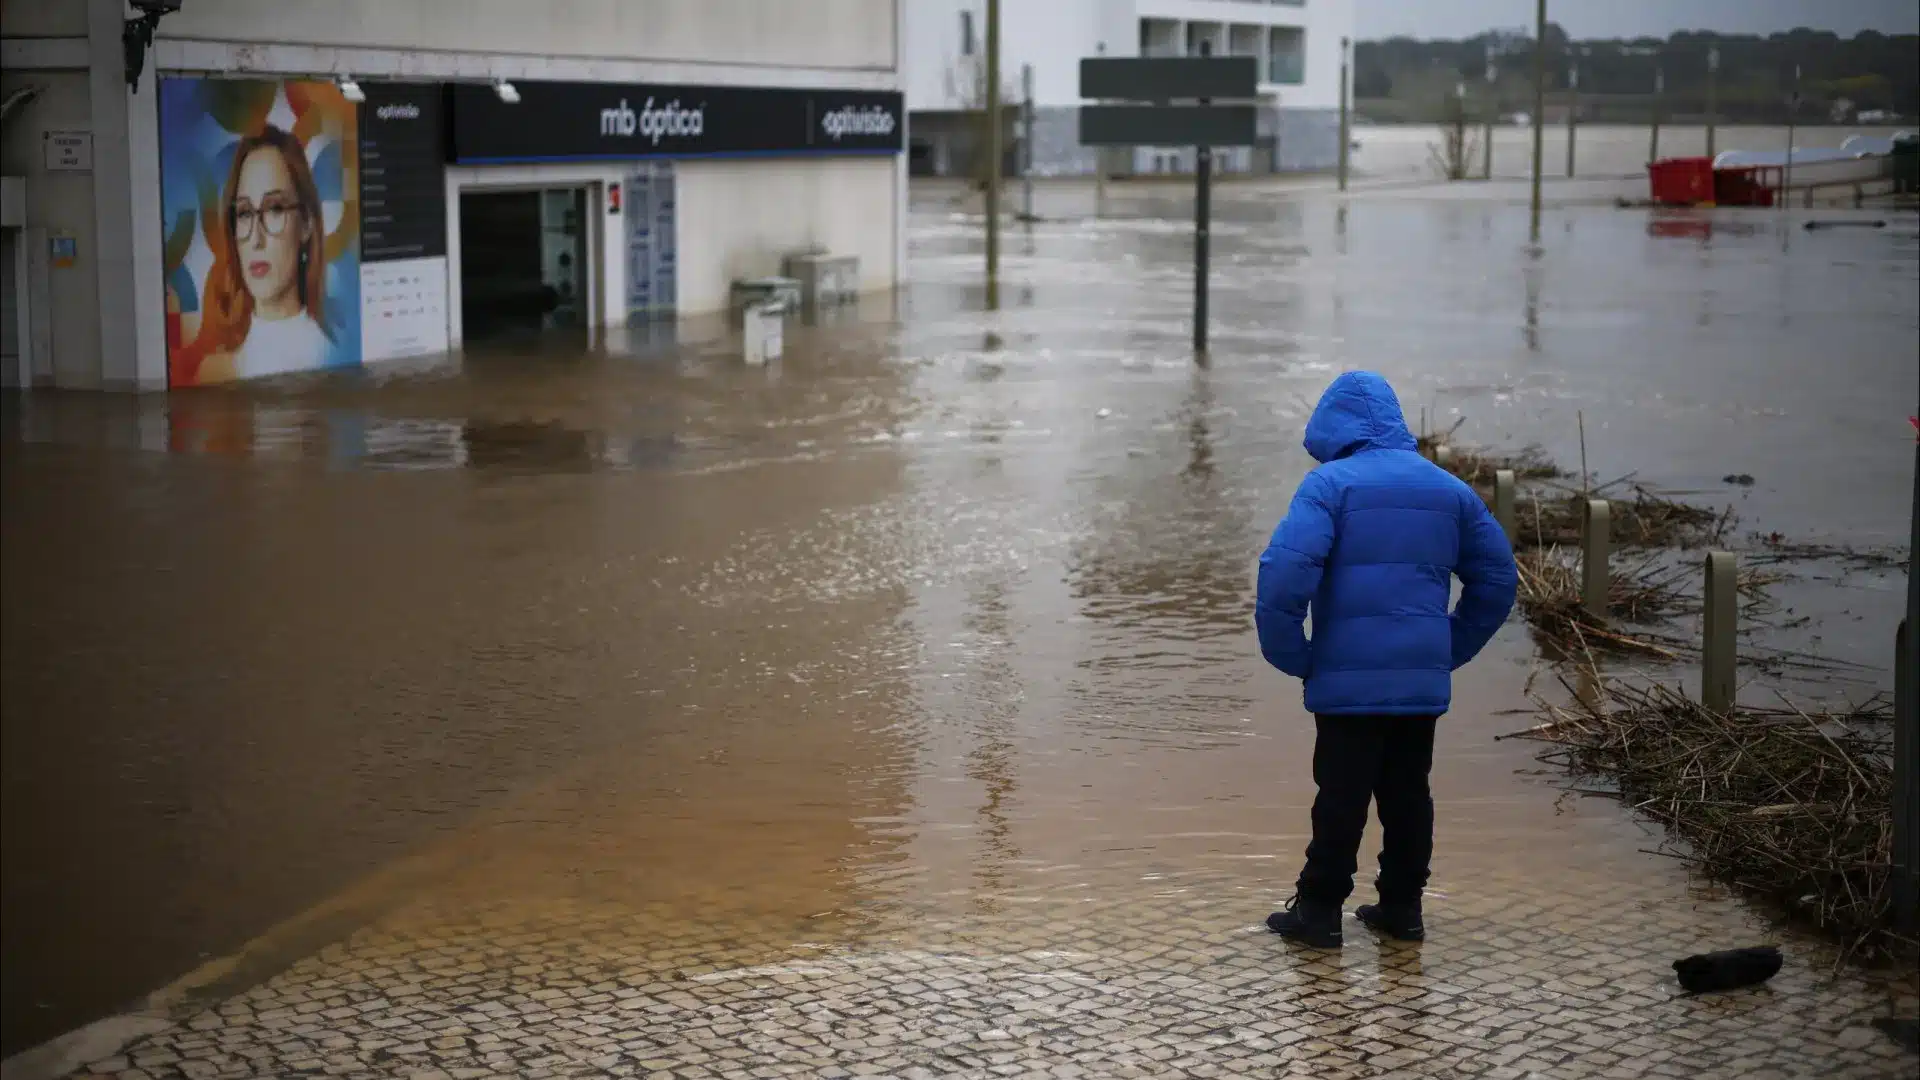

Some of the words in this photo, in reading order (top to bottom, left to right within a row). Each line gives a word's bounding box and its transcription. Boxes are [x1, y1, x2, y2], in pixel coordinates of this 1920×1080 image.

[601, 98, 636, 136] mb
[640, 96, 704, 146] óptica
[822, 104, 895, 141] optivisão
